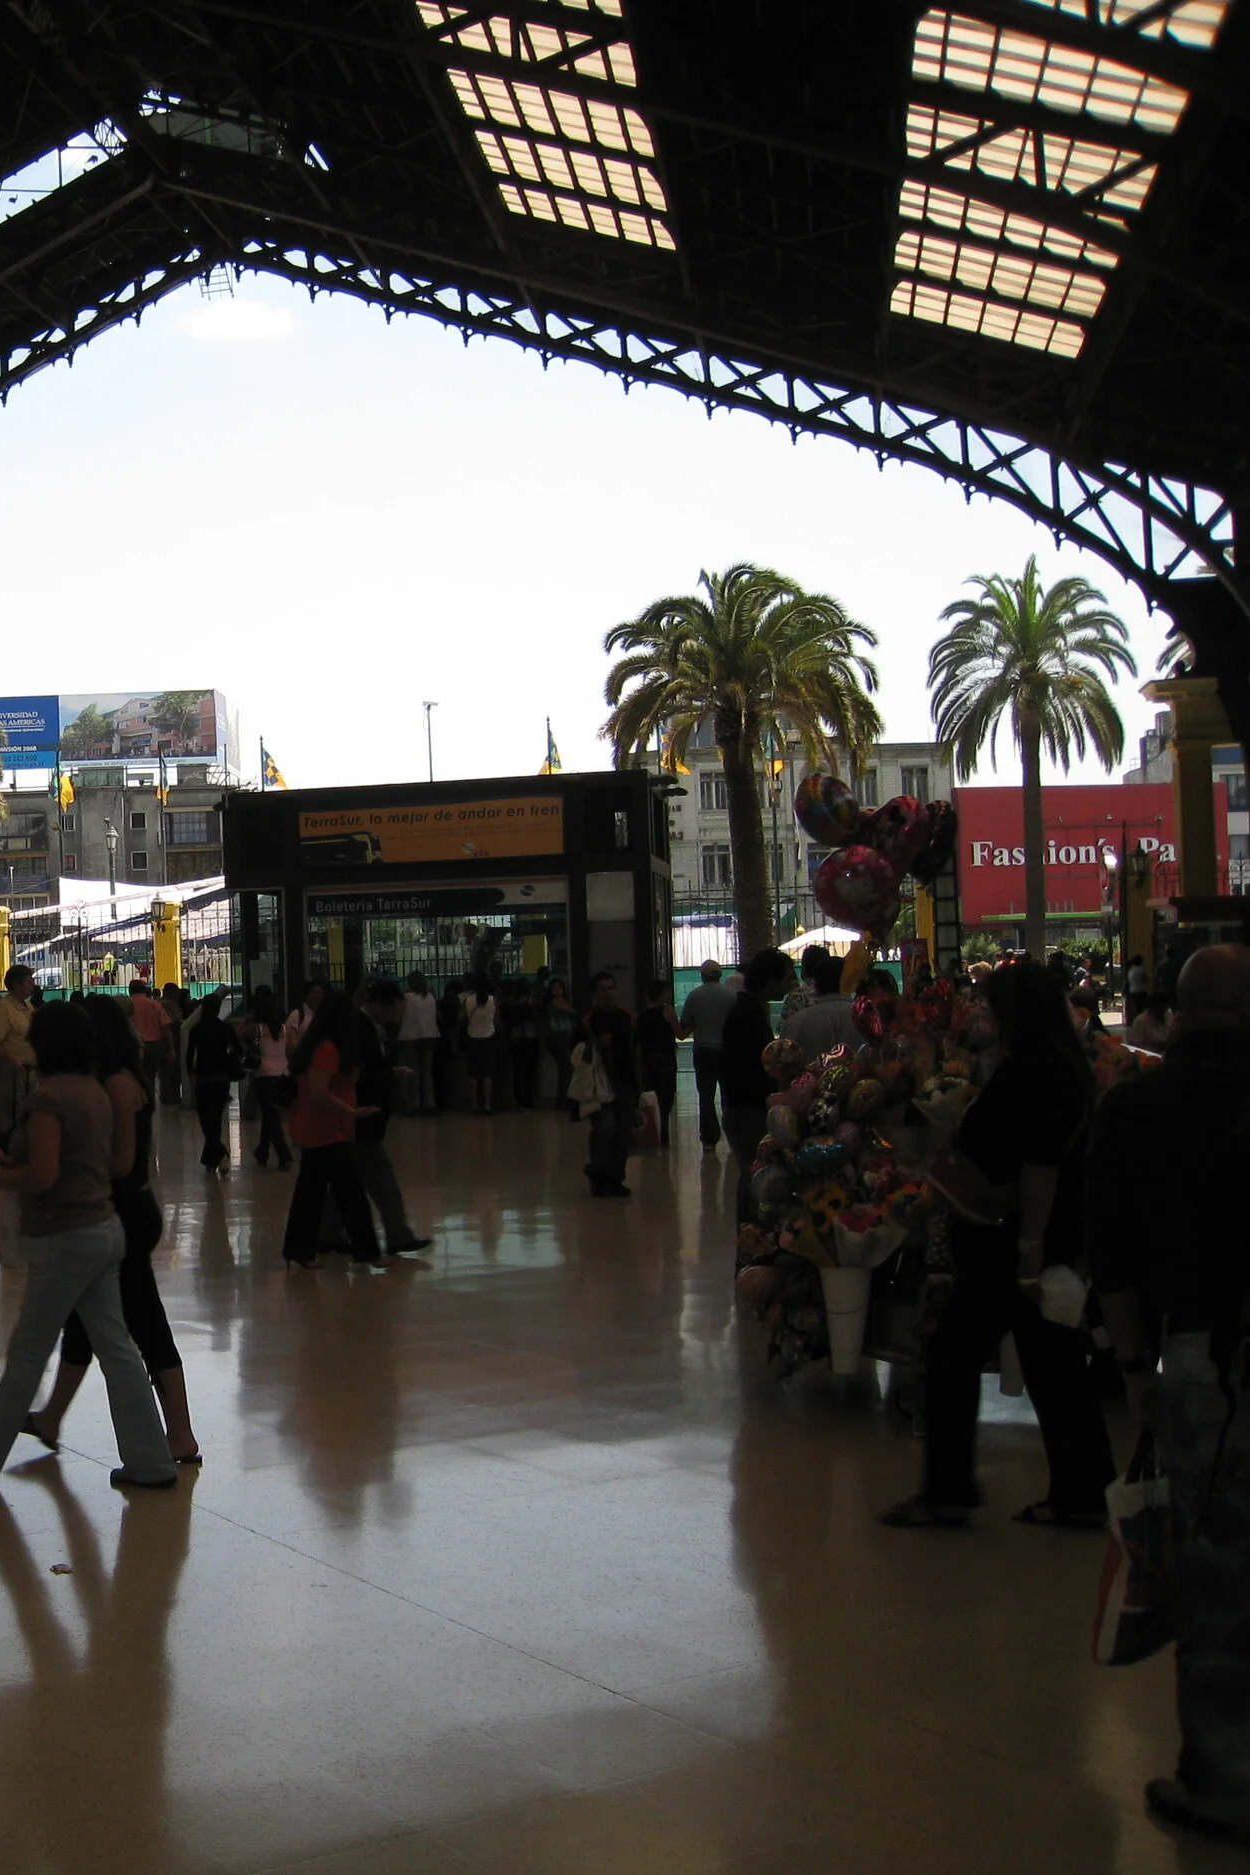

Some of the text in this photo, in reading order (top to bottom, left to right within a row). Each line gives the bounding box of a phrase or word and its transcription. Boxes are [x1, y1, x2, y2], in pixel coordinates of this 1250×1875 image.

[387, 810, 429, 826] mejor
[433, 808, 452, 821] de
[457, 807, 502, 820] andar
[506, 808, 525, 817] en
[969, 838, 1118, 867] Fasion's
[377, 896, 433, 911] TerraSur
